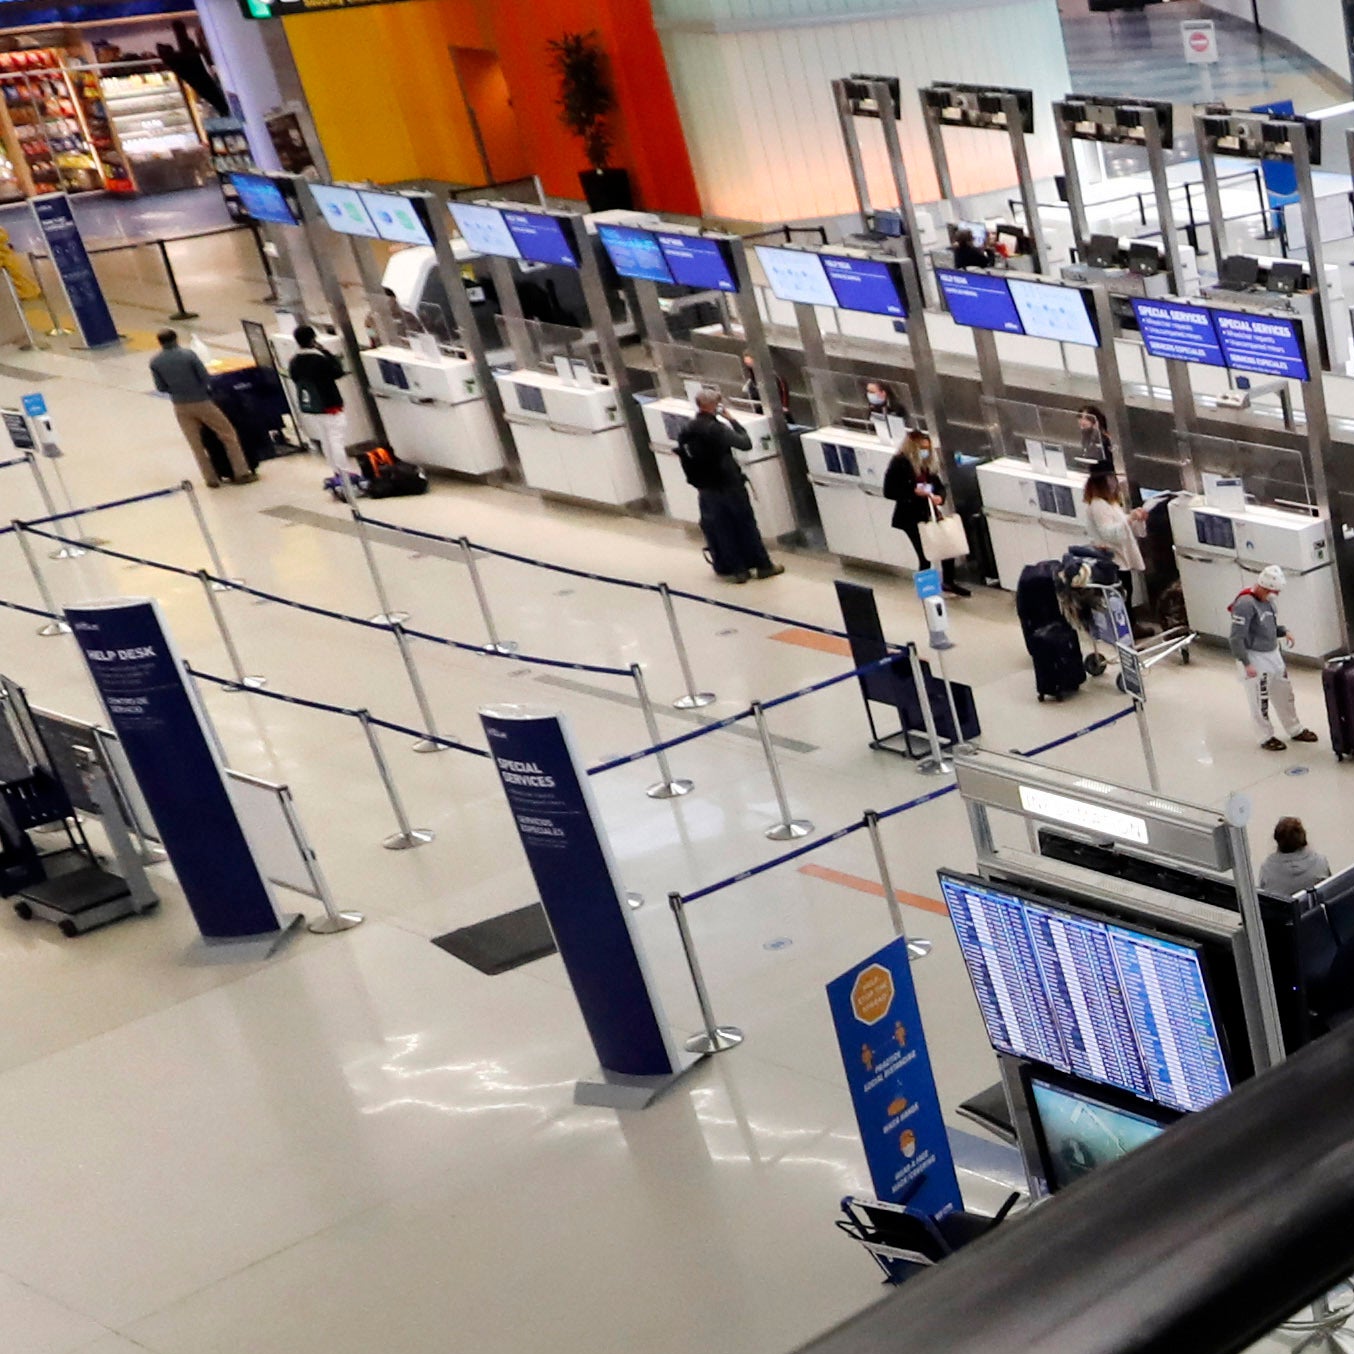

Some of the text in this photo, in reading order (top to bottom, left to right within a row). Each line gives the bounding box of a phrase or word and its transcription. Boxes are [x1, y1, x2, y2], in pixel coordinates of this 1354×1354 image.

[1138, 305, 1208, 326] SPECIAL SERVICES
[1218, 317, 1291, 338] SPECIAL SERVICES
[86, 645, 157, 661] HELP DESK
[497, 757, 544, 774] SPECIAL
[501, 771, 556, 788] SERVICES
[874, 1049, 901, 1074] PRACTICE
[863, 1074, 884, 1092] SOCIAL
